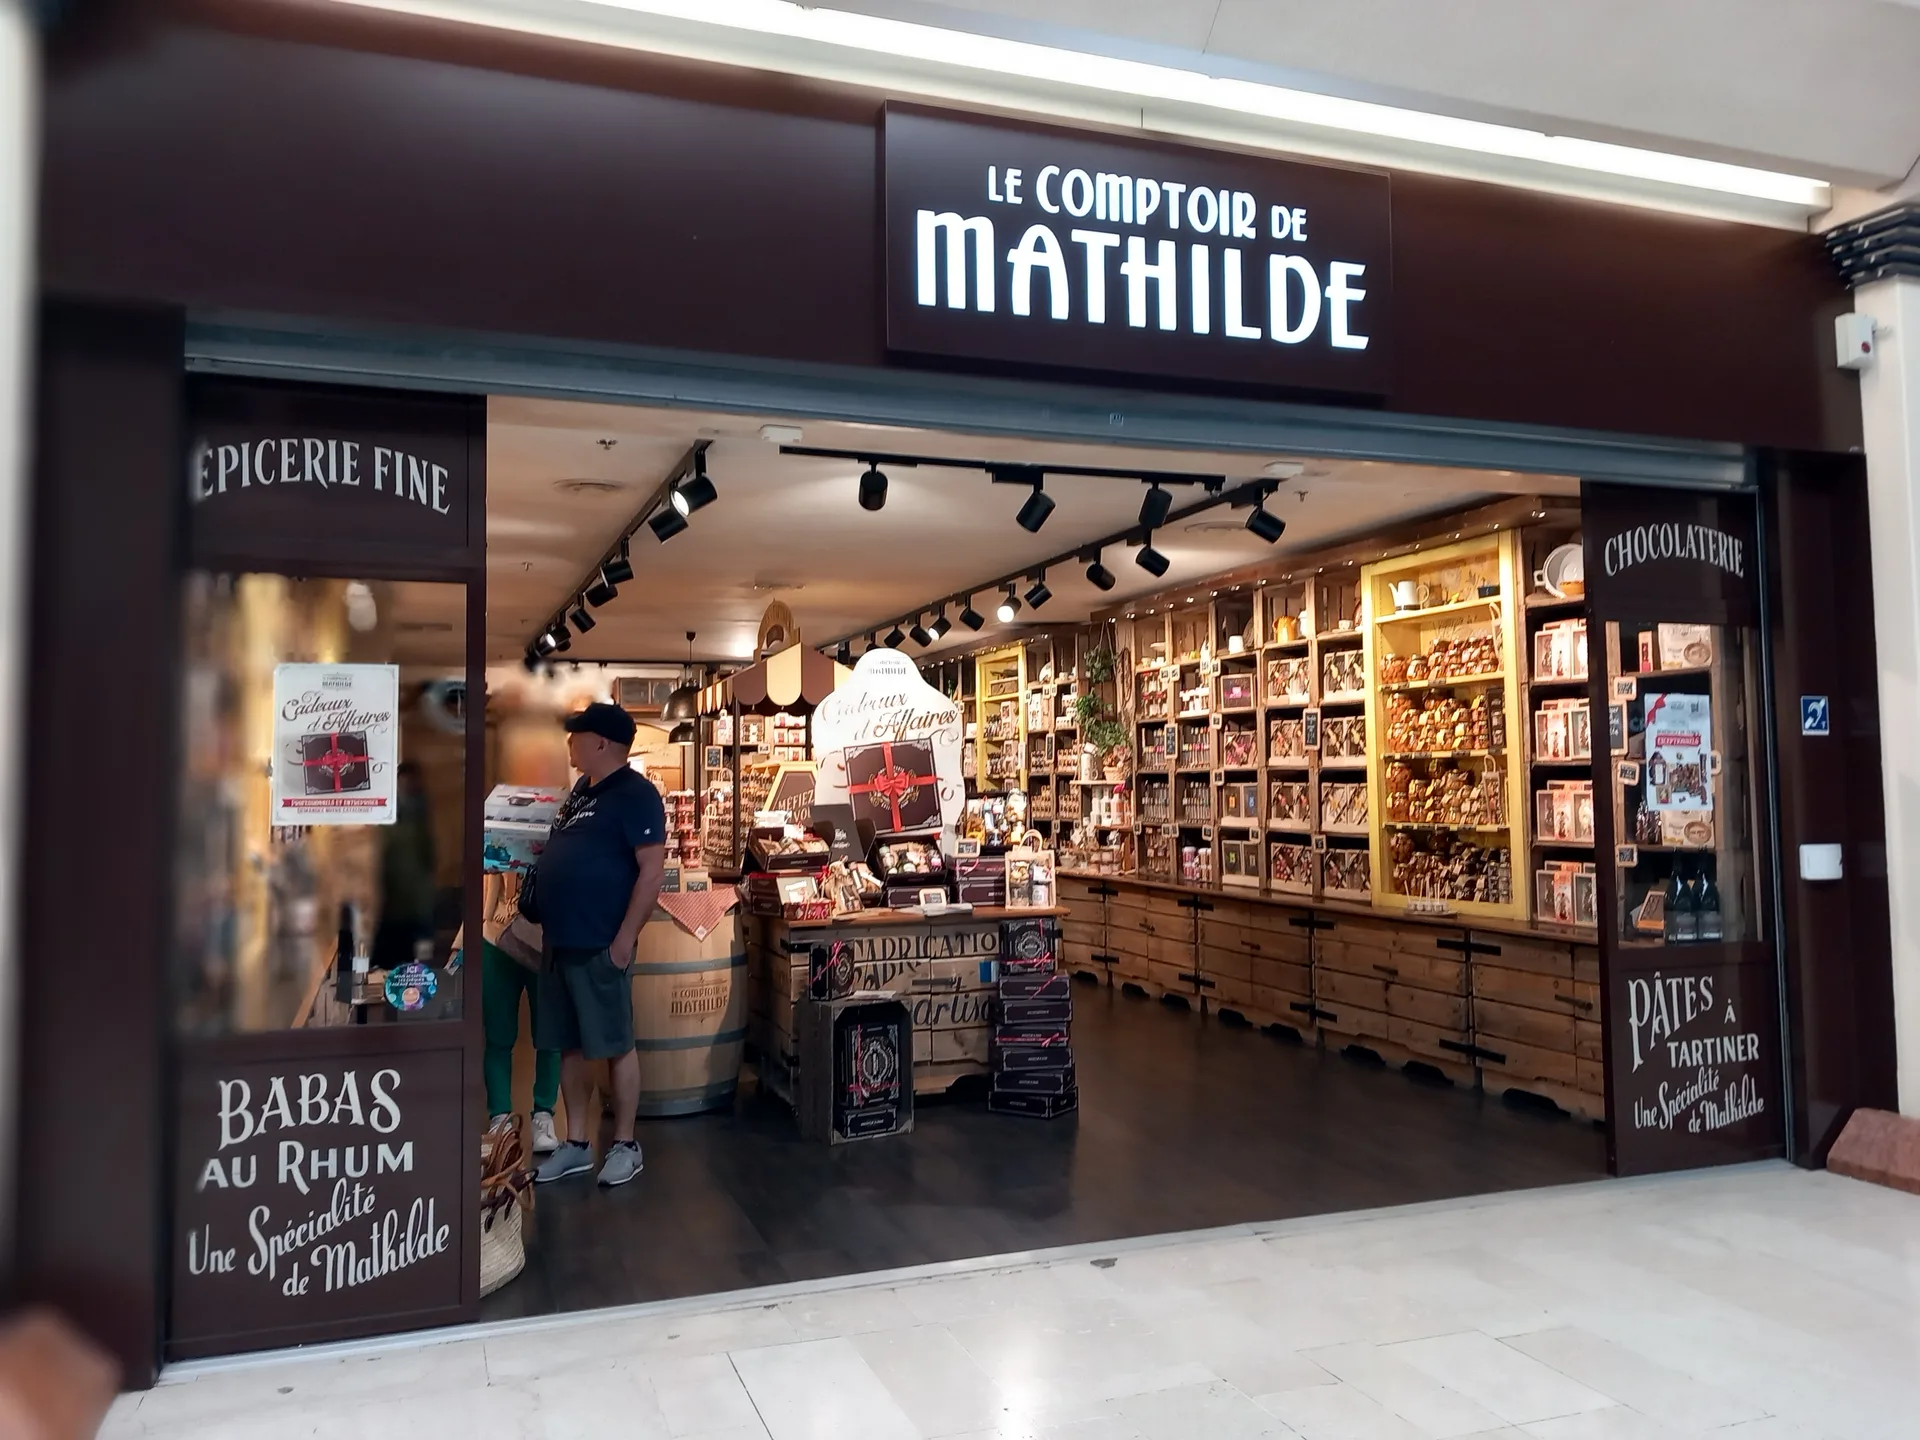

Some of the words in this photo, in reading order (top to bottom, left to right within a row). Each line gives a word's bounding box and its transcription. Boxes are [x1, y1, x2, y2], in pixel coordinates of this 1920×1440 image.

[987, 165, 1023, 204] LE
[1036, 164, 1256, 239] COMPTOIR
[1271, 205, 1308, 242] DE
[916, 209, 1369, 350] MATHILDE
[373, 446, 450, 515] FINE
[1604, 522, 1744, 578] CHOCOLATERIE
[282, 691, 353, 721] Cadeaux
[851, 933, 996, 990] FABRICATIO
[671, 995, 728, 1014] MATHILDE
[1628, 971, 1714, 1073] PÂTES
[1667, 1033, 1759, 1068] TARTINER
[217, 1068, 401, 1151] BABAS
[1635, 1096, 1658, 1129] Une
[1658, 1066, 1720, 1132] Spécialité
[1688, 1110, 1701, 1134] de
[1700, 1073, 1764, 1132] Mathilde
[197, 1155, 257, 1191] AU
[278, 1140, 414, 1195] RHUM
[188, 1224, 237, 1275] Une
[247, 1177, 376, 1282] Spécialité
[282, 1262, 309, 1297] de
[310, 1198, 450, 1293] Mathilde
